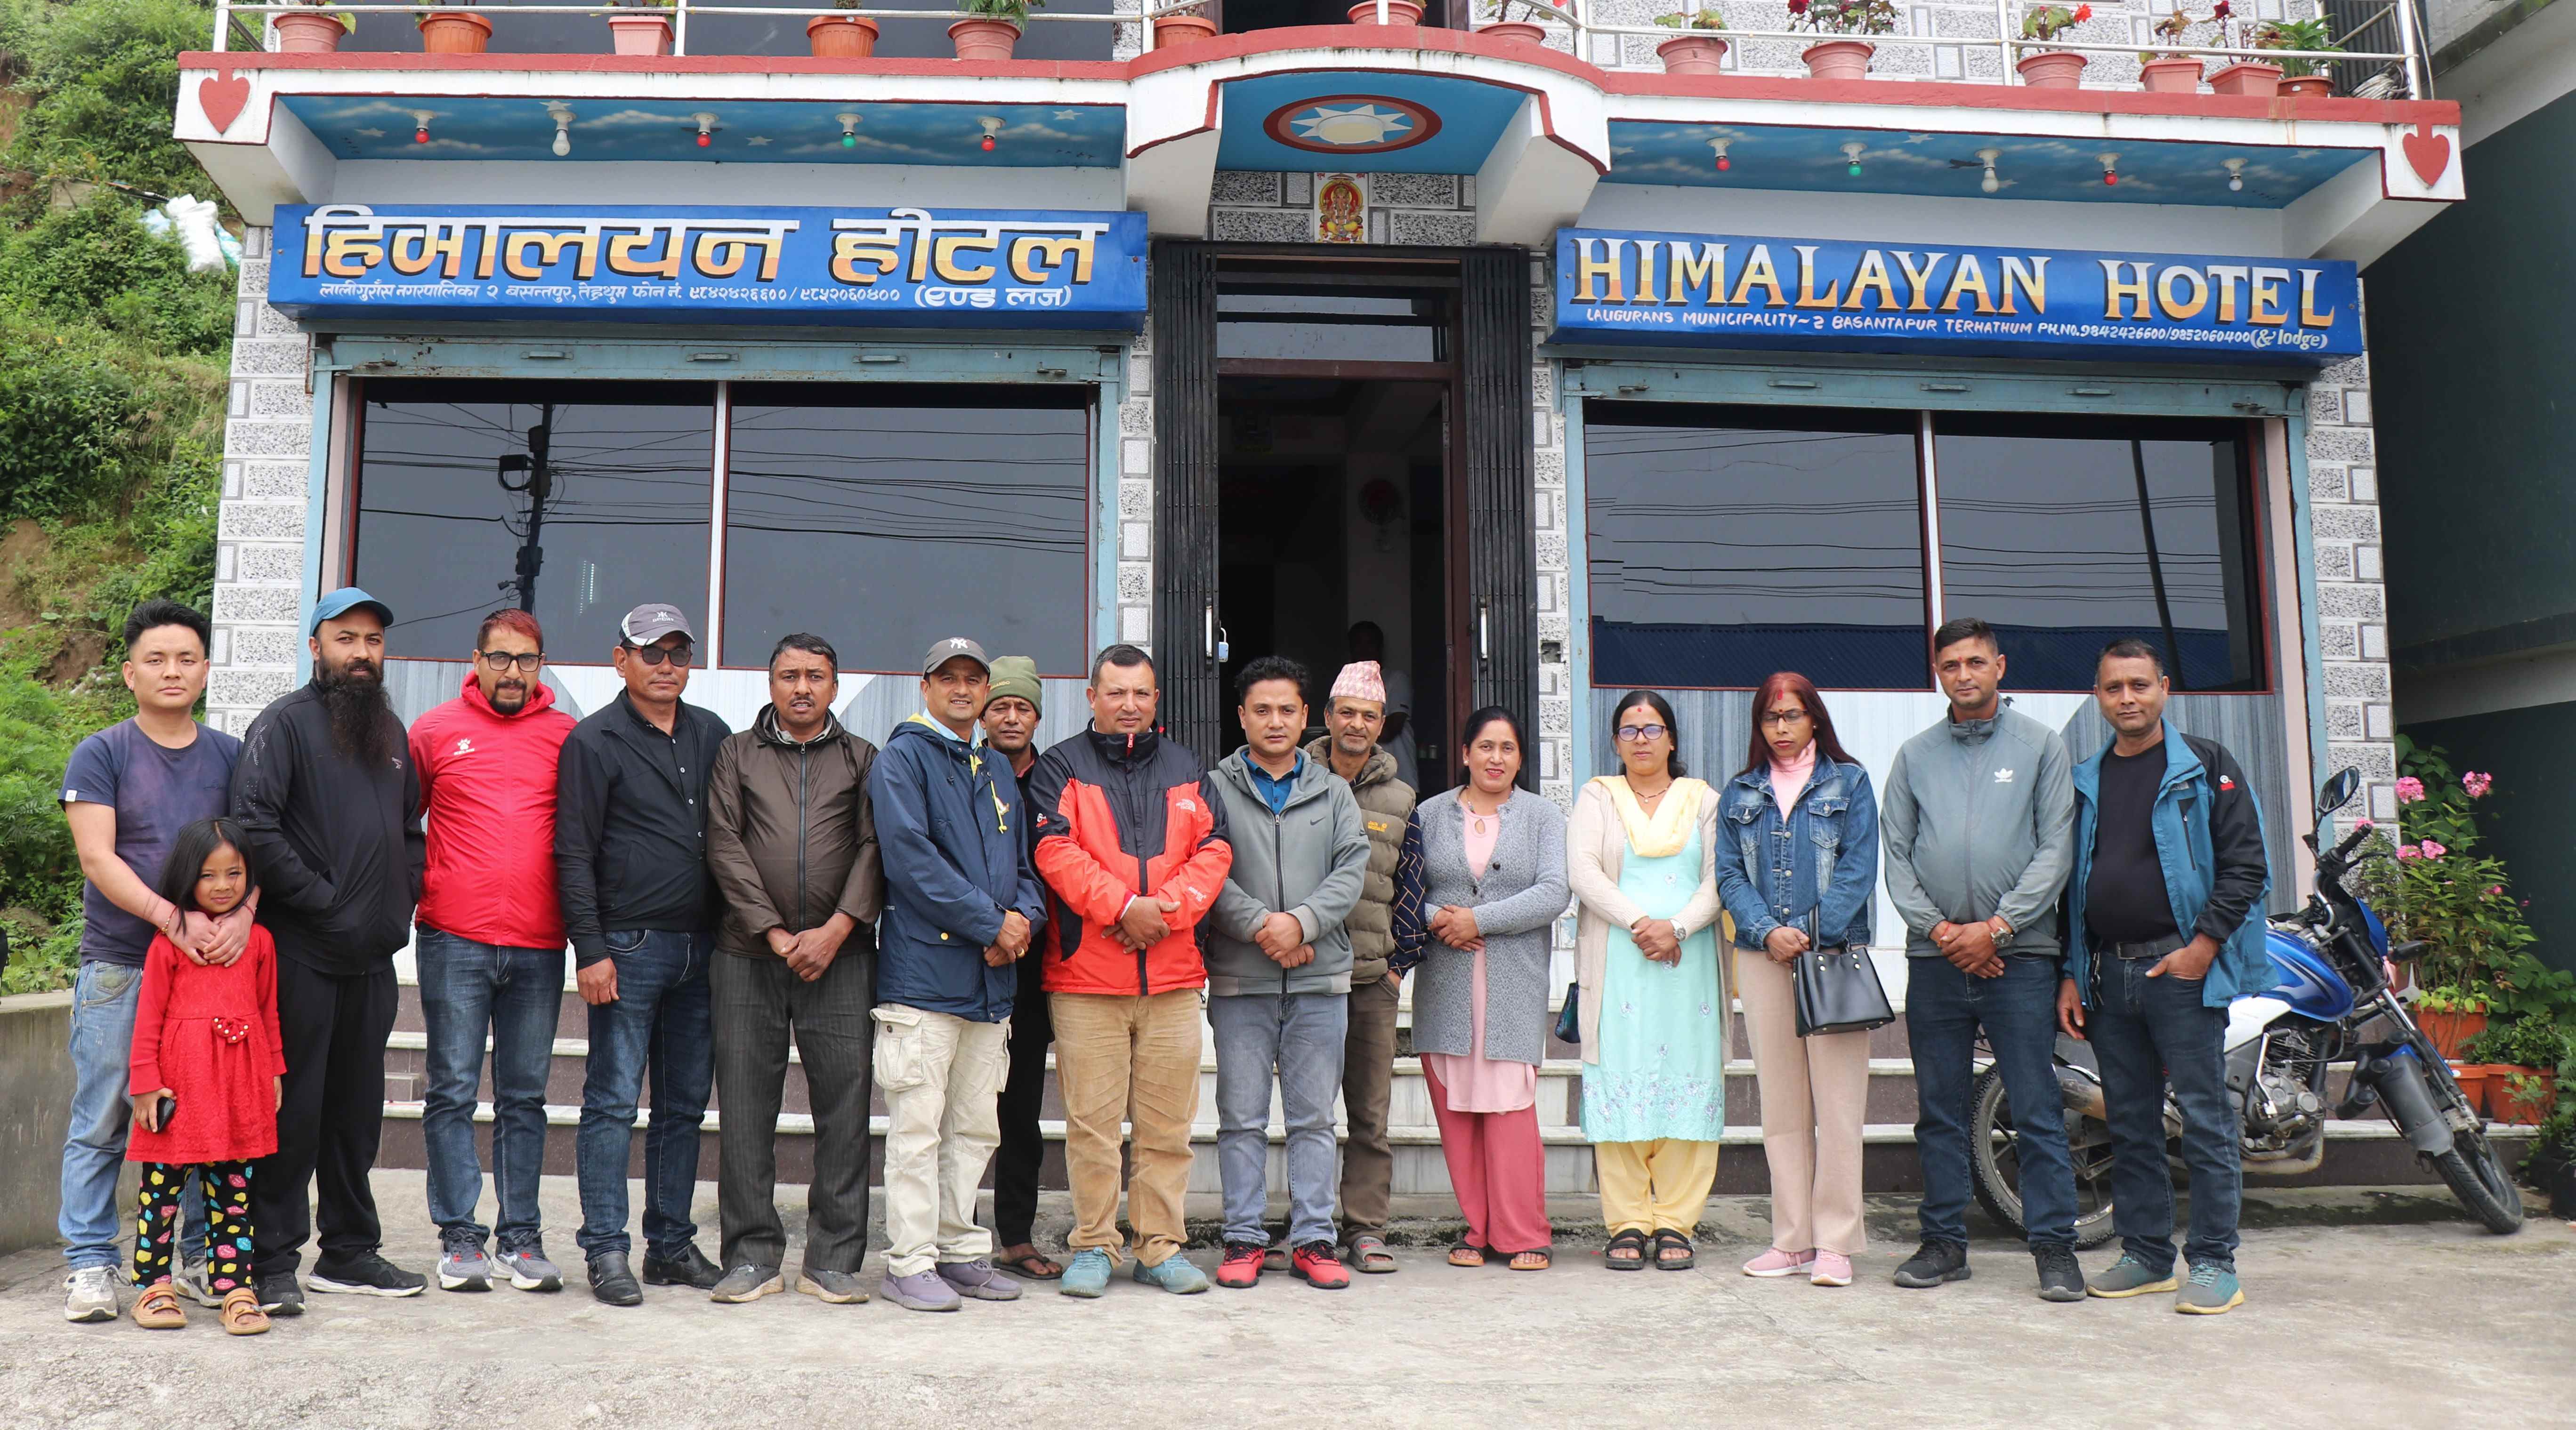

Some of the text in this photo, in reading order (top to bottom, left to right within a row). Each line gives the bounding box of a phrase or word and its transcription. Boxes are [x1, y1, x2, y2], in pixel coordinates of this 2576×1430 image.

[302, 204, 799, 281] हिमालयन
[396, 282, 480, 299] नगरपालिका
[486, 285, 499, 300] २
[632, 281, 665, 299] फोन
[1005, 285, 1072, 307] लज)
[1571, 237, 2334, 328] HIMALAYAN HOTEL
[1586, 308, 1674, 324] LALIGURANS
[1832, 315, 1938, 333] BASANTAPUR
[1945, 318, 2033, 335] TERHATHUM
